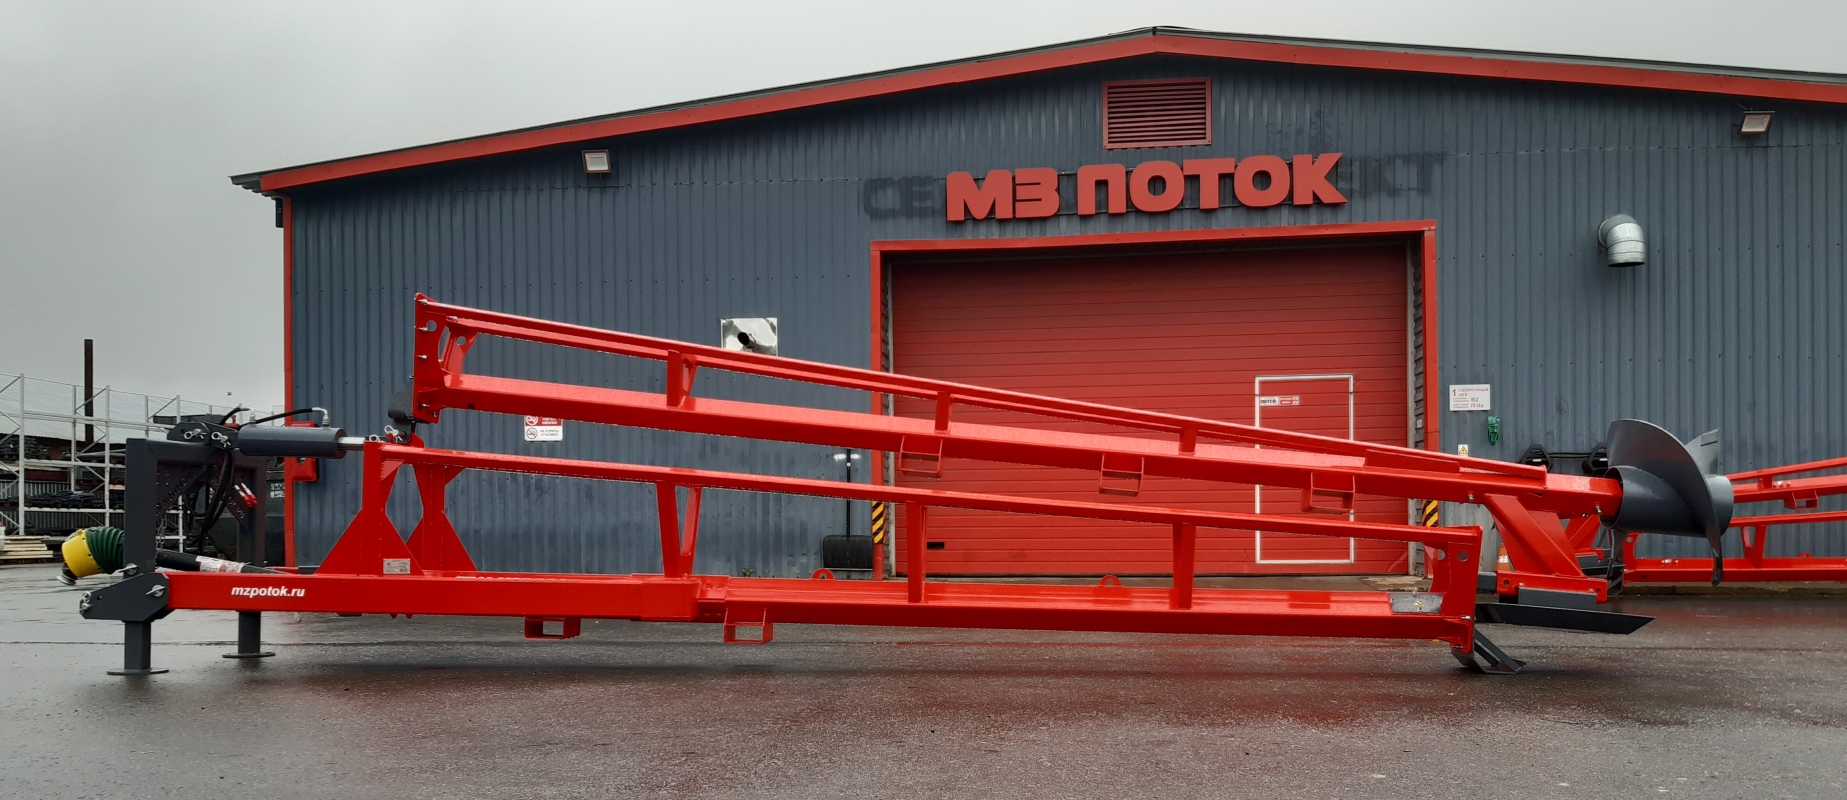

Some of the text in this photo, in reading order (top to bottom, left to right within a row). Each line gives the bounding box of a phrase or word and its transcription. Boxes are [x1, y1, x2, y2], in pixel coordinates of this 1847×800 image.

[946, 167, 1060, 222] МЗ
[1077, 152, 1348, 216] ПОТОК
[1452, 388, 1456, 396] 1
[231, 586, 306, 599] mzpotok.ru
